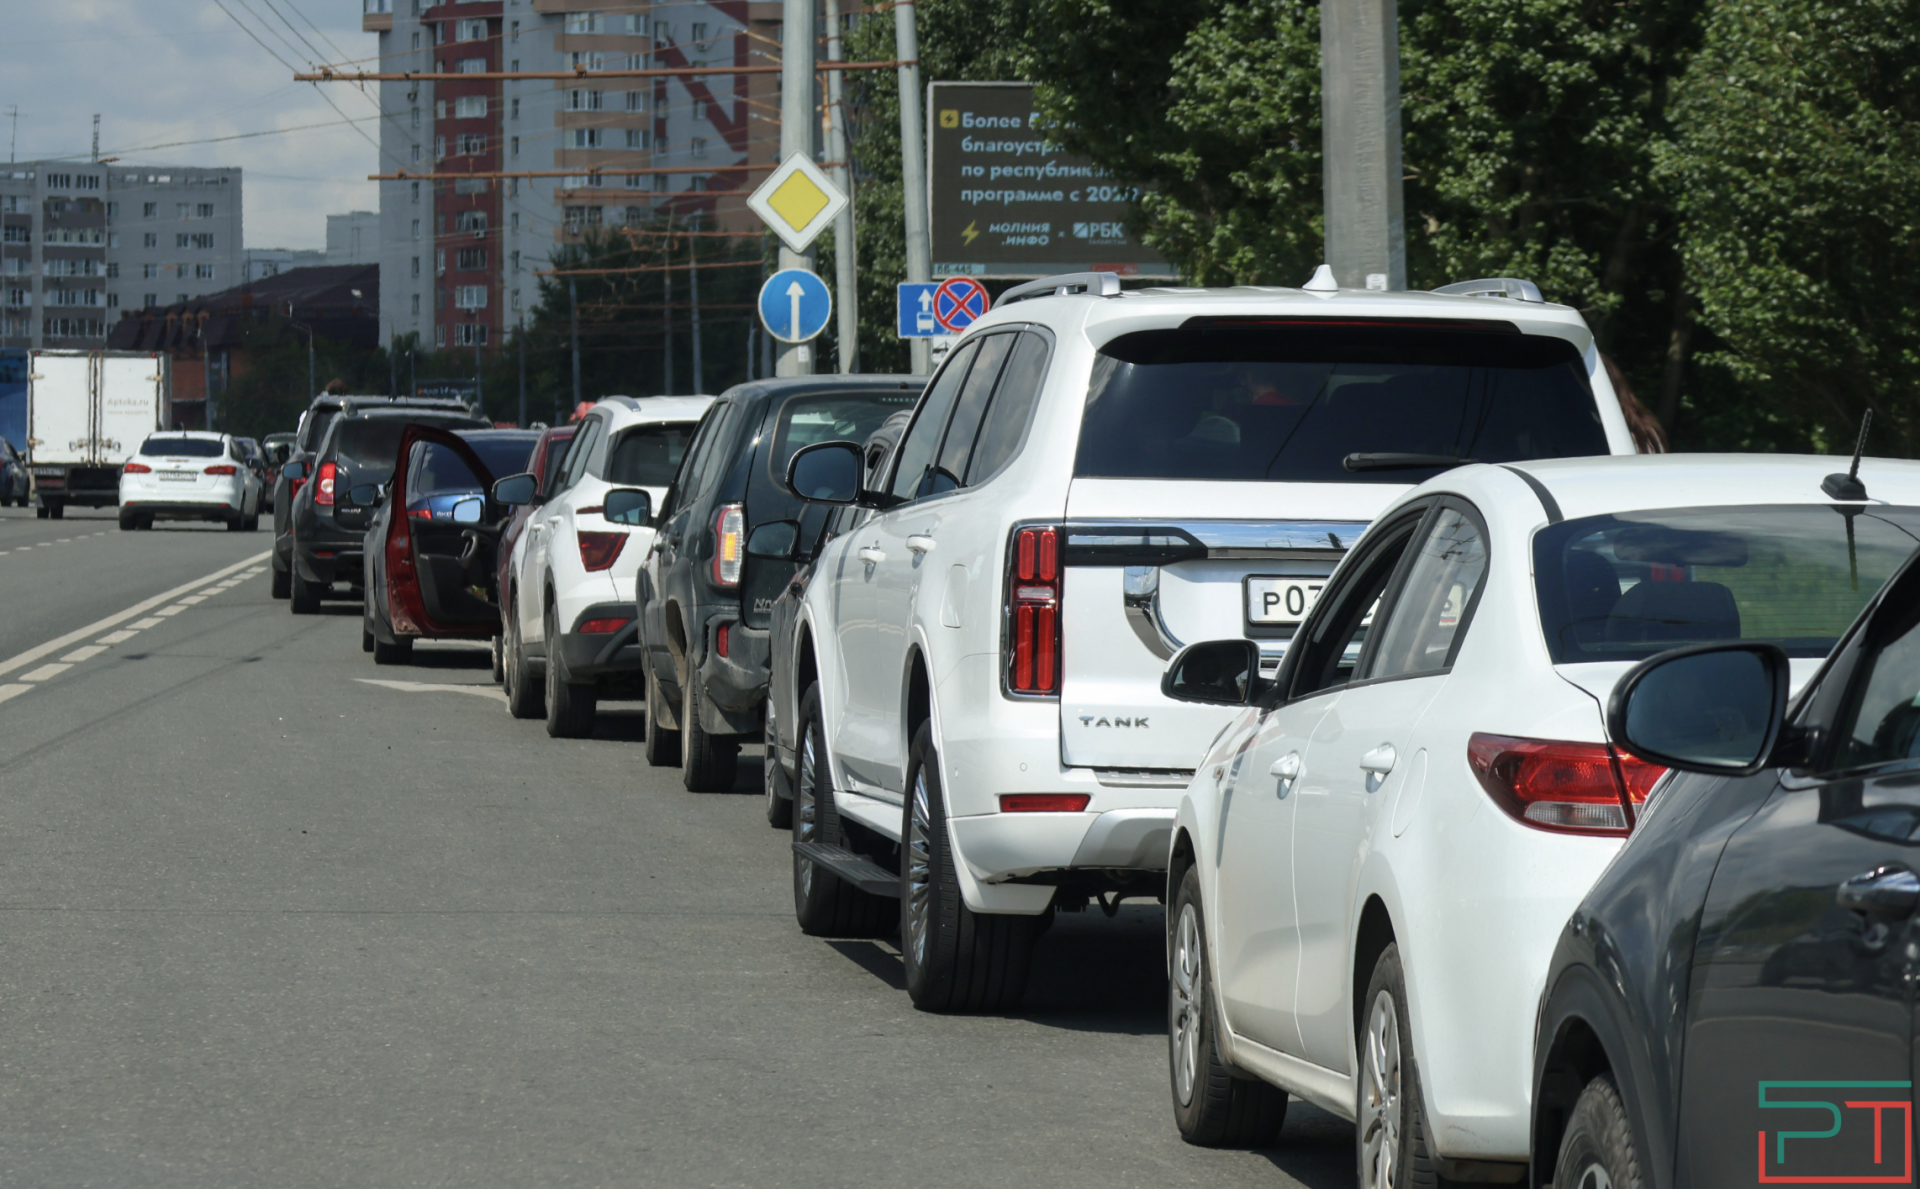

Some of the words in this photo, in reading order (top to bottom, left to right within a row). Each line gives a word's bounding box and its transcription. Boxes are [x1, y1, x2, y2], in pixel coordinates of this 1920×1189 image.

[962, 112, 1021, 128] Более
[961, 135, 1065, 156] благоустр
[961, 165, 985, 177] по
[961, 189, 1064, 205] программе
[1069, 190, 1080, 201] с
[1089, 222, 1124, 238] РБК
[1078, 715, 1149, 728] TANK
